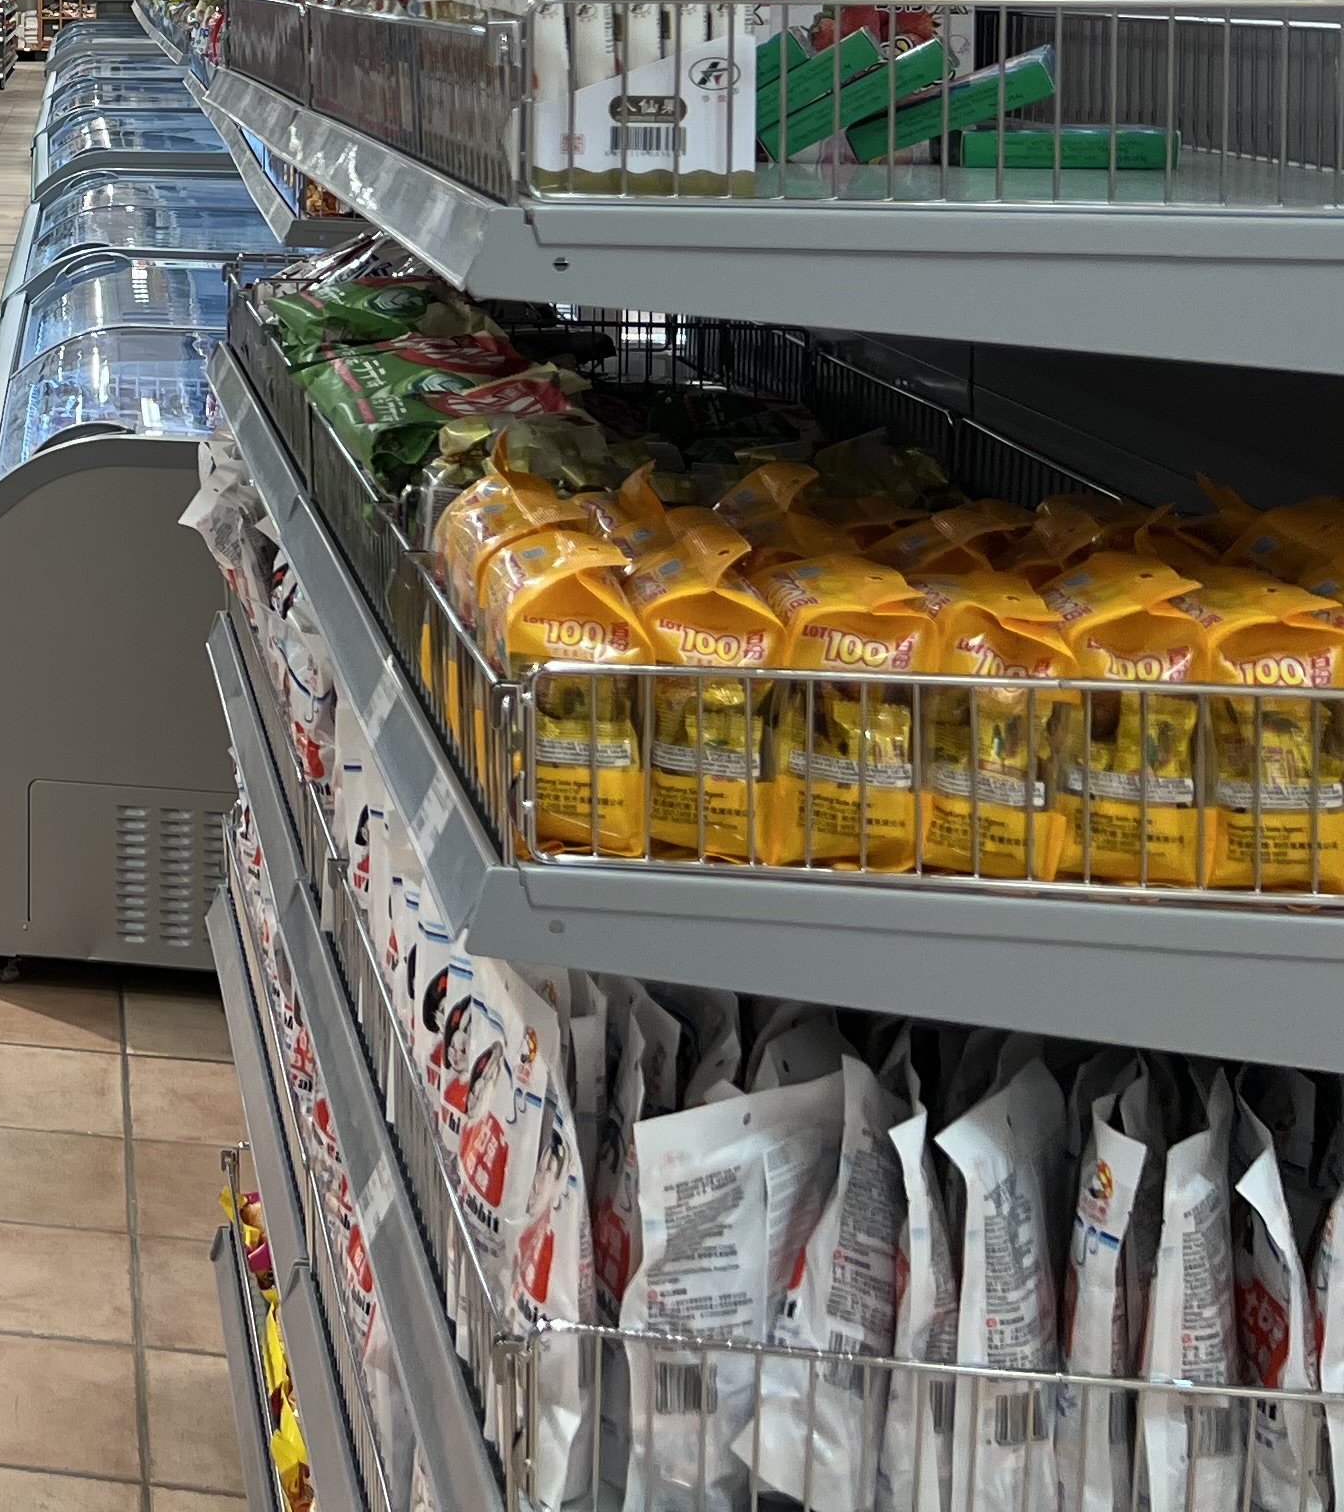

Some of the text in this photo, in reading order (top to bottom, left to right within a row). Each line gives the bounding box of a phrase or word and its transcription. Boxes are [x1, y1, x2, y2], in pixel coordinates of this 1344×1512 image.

[545, 619, 604, 651] 100
[682, 627, 740, 662] 100
[824, 629, 889, 668] 100
